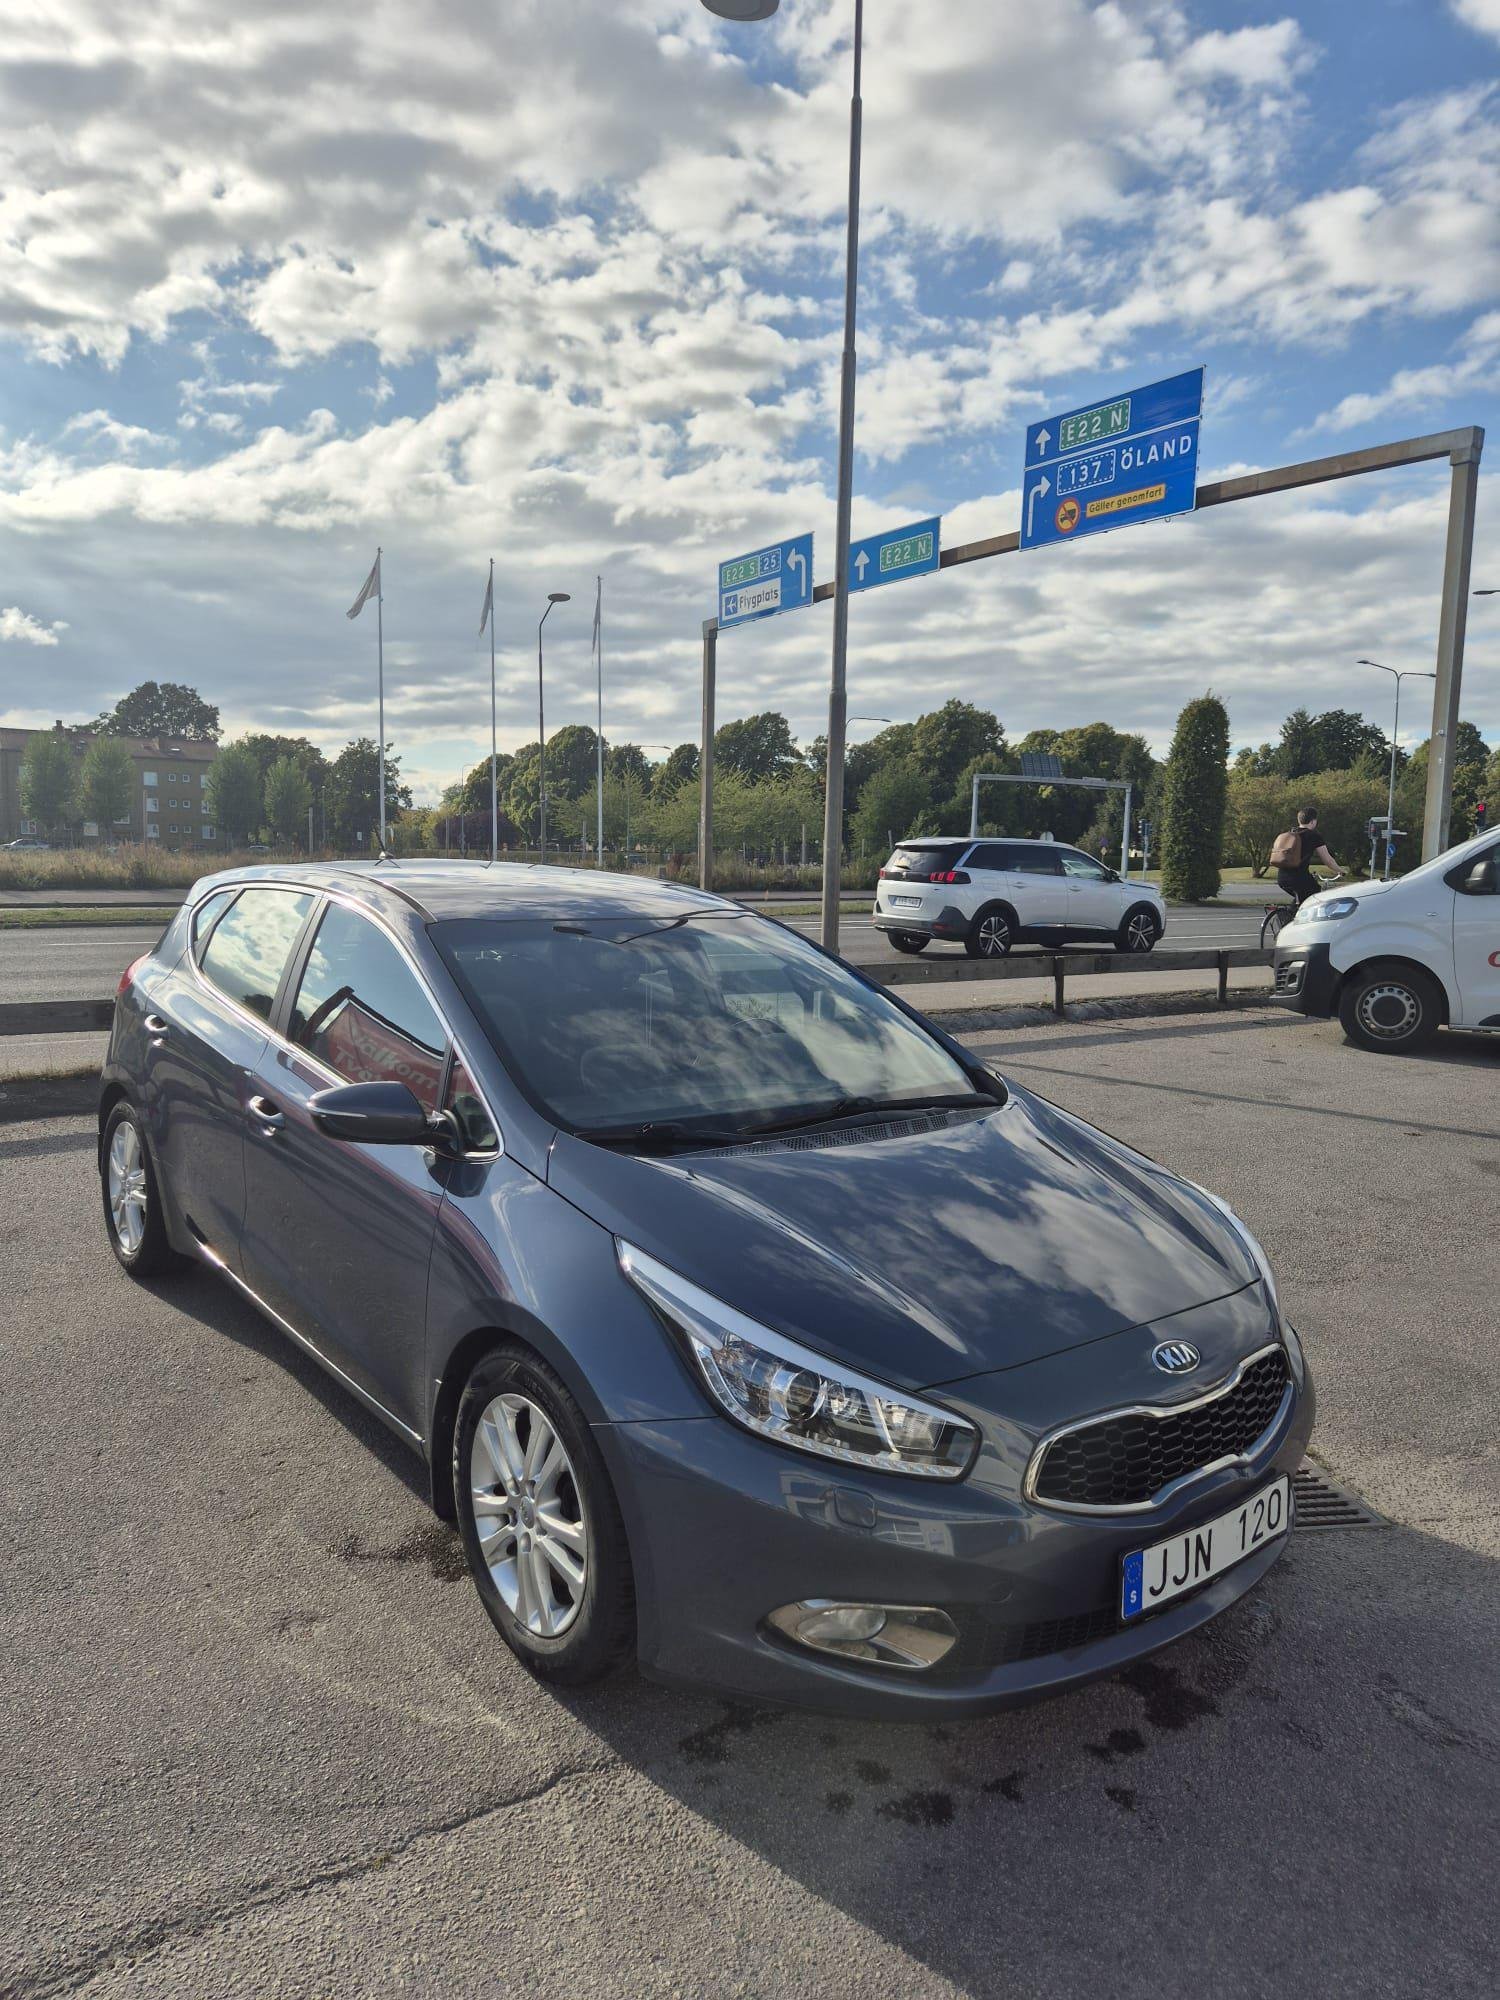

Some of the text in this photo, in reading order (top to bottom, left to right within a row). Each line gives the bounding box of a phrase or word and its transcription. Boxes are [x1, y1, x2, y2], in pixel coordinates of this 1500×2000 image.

[1066, 407, 1122, 442] E22 N
[1070, 435, 1192, 485] 137 ÖLAND
[1089, 487, 1162, 513] Gäller genomfart
[886, 540, 926, 564] E22 N
[726, 554, 776, 581] E22 S 25
[740, 589, 779, 609] Flygplats
[1158, 1343, 1197, 1369] KIA
[1149, 1487, 1282, 1597] JJN 120
[1130, 1590, 1137, 1603] S
